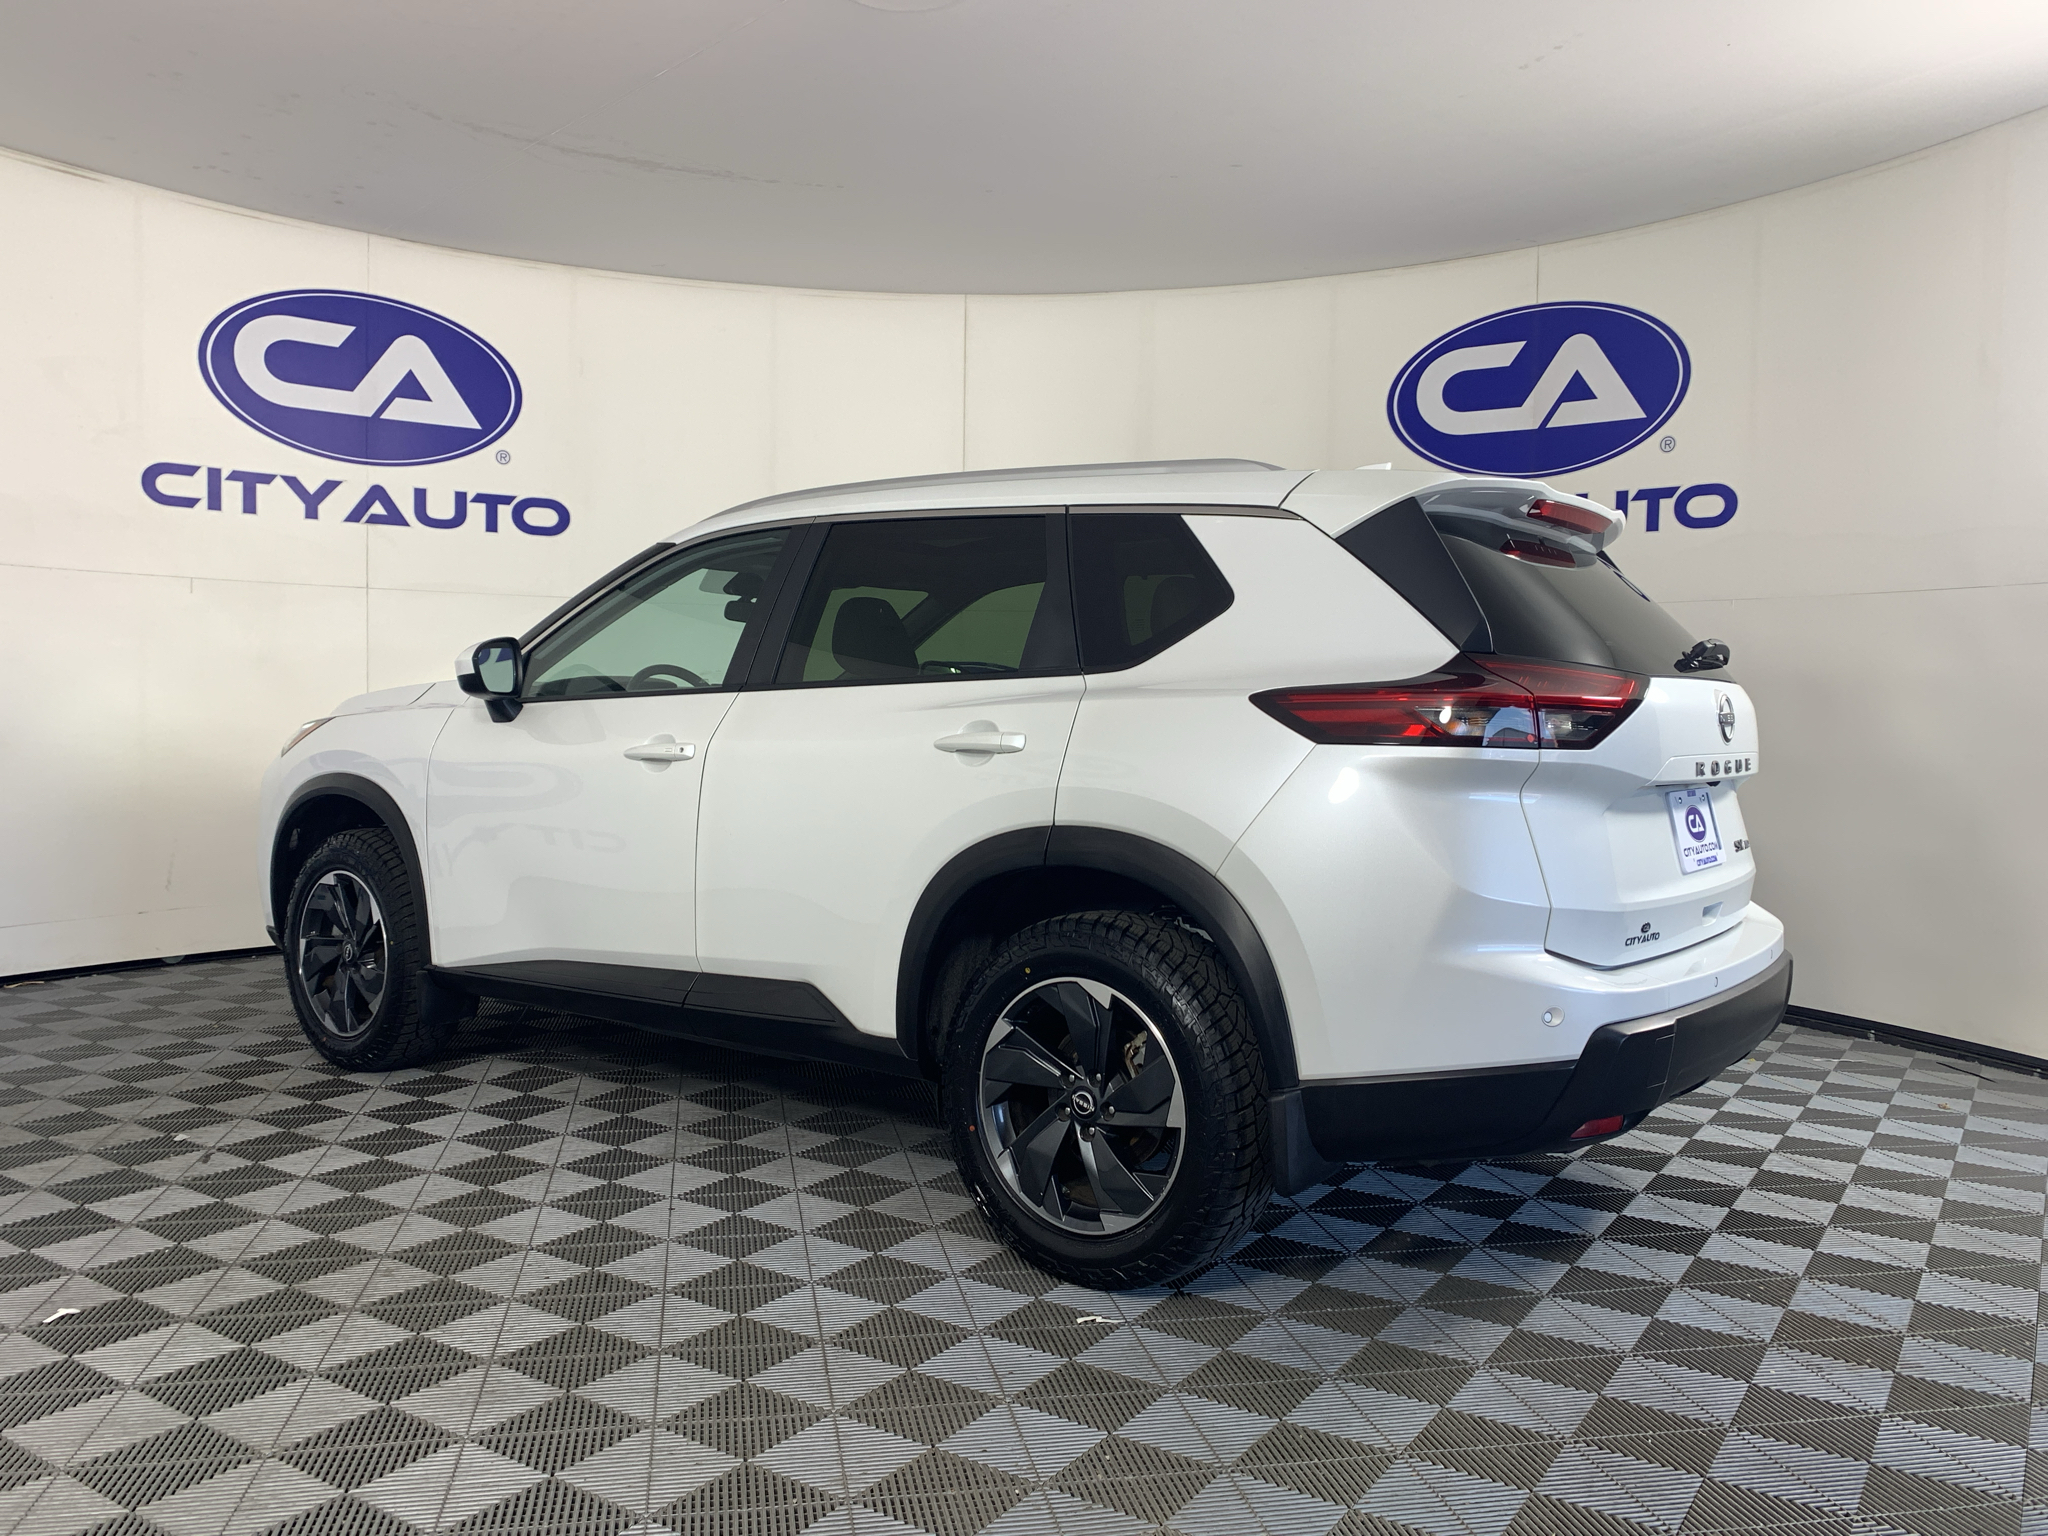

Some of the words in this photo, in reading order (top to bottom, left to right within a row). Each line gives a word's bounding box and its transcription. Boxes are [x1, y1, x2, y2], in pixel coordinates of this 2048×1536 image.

[233, 314, 482, 430] CA
[1416, 333, 1648, 436] CA
[1695, 758, 1751, 777] ROGUE
